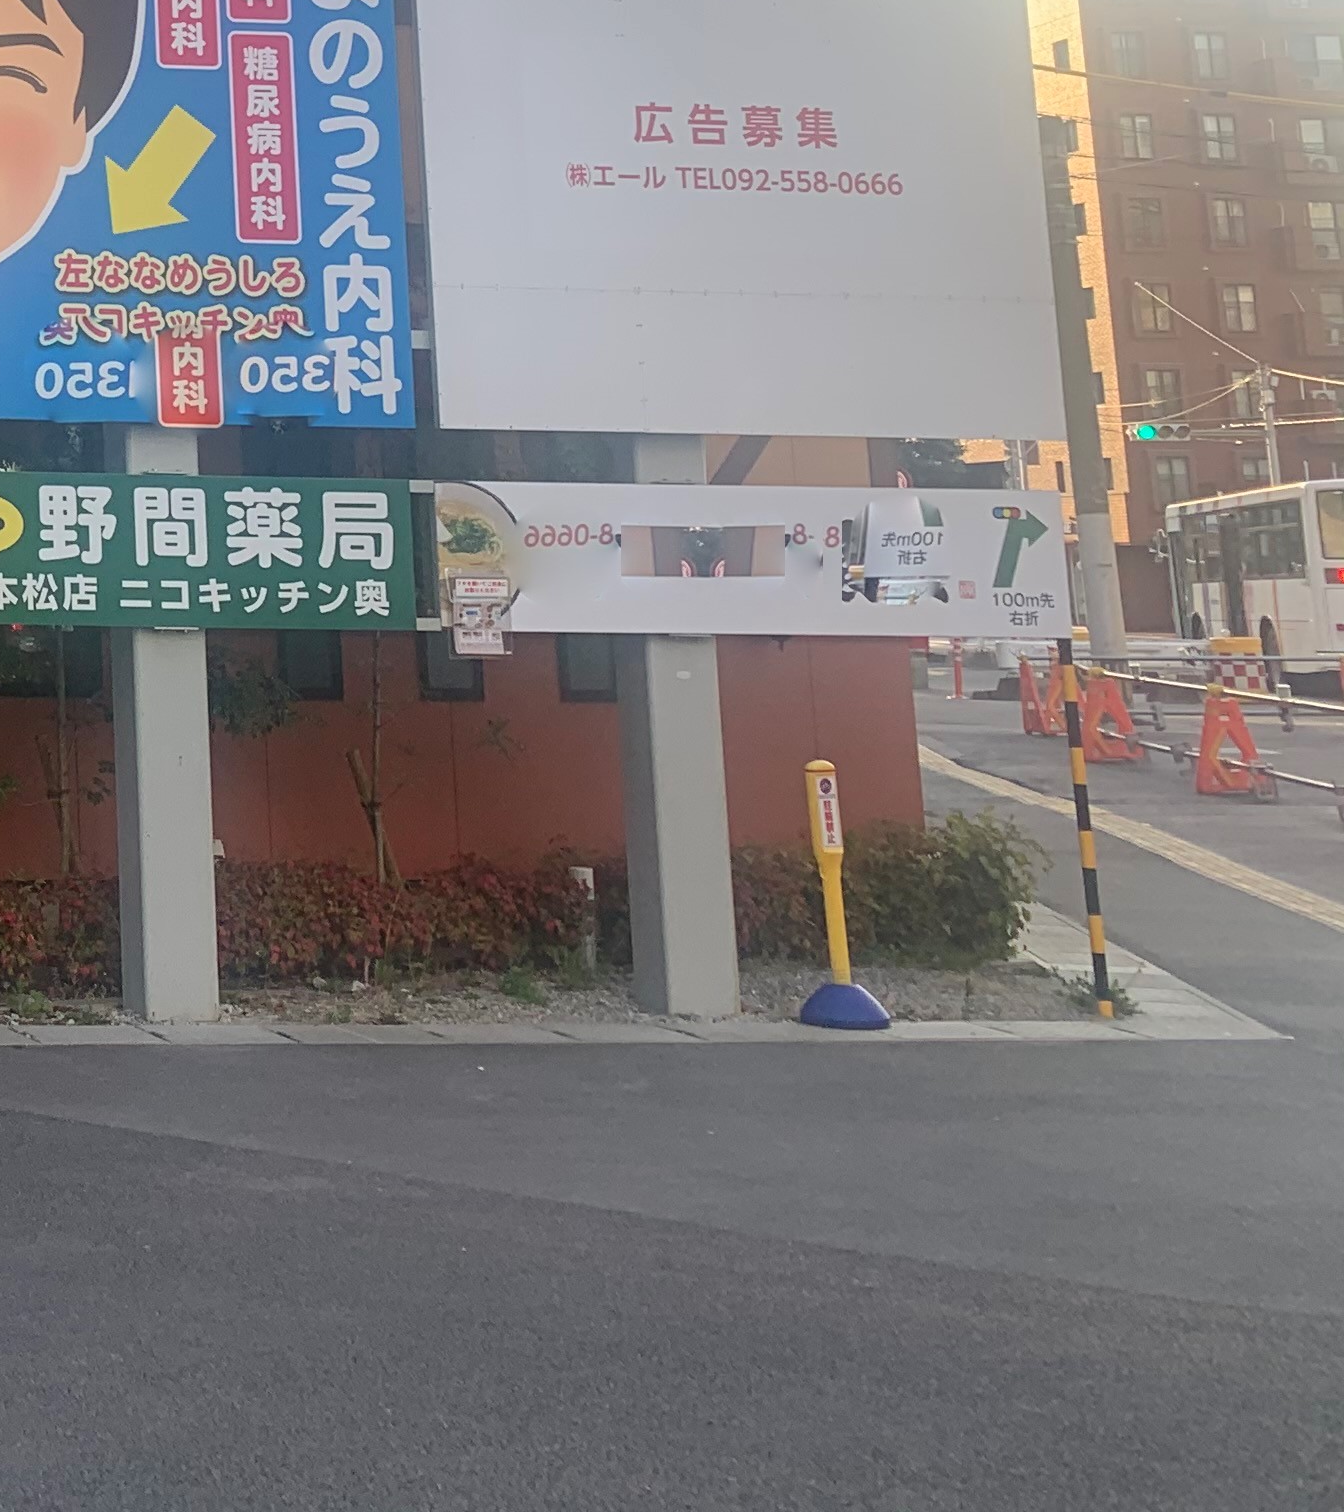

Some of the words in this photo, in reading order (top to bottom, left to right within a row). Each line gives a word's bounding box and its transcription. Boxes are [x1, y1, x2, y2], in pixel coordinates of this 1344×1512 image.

[243, 45, 286, 230] 糖尿病内科
[633, 101, 838, 149] 広告募集
[55, 249, 306, 297] 左ななめうしろ
[38, 485, 395, 570] 野間薬局
[119, 578, 390, 617] ニコキッチン奥
[993, 592, 1055, 608] 100m先
[1009, 610, 1039, 626] 右折
